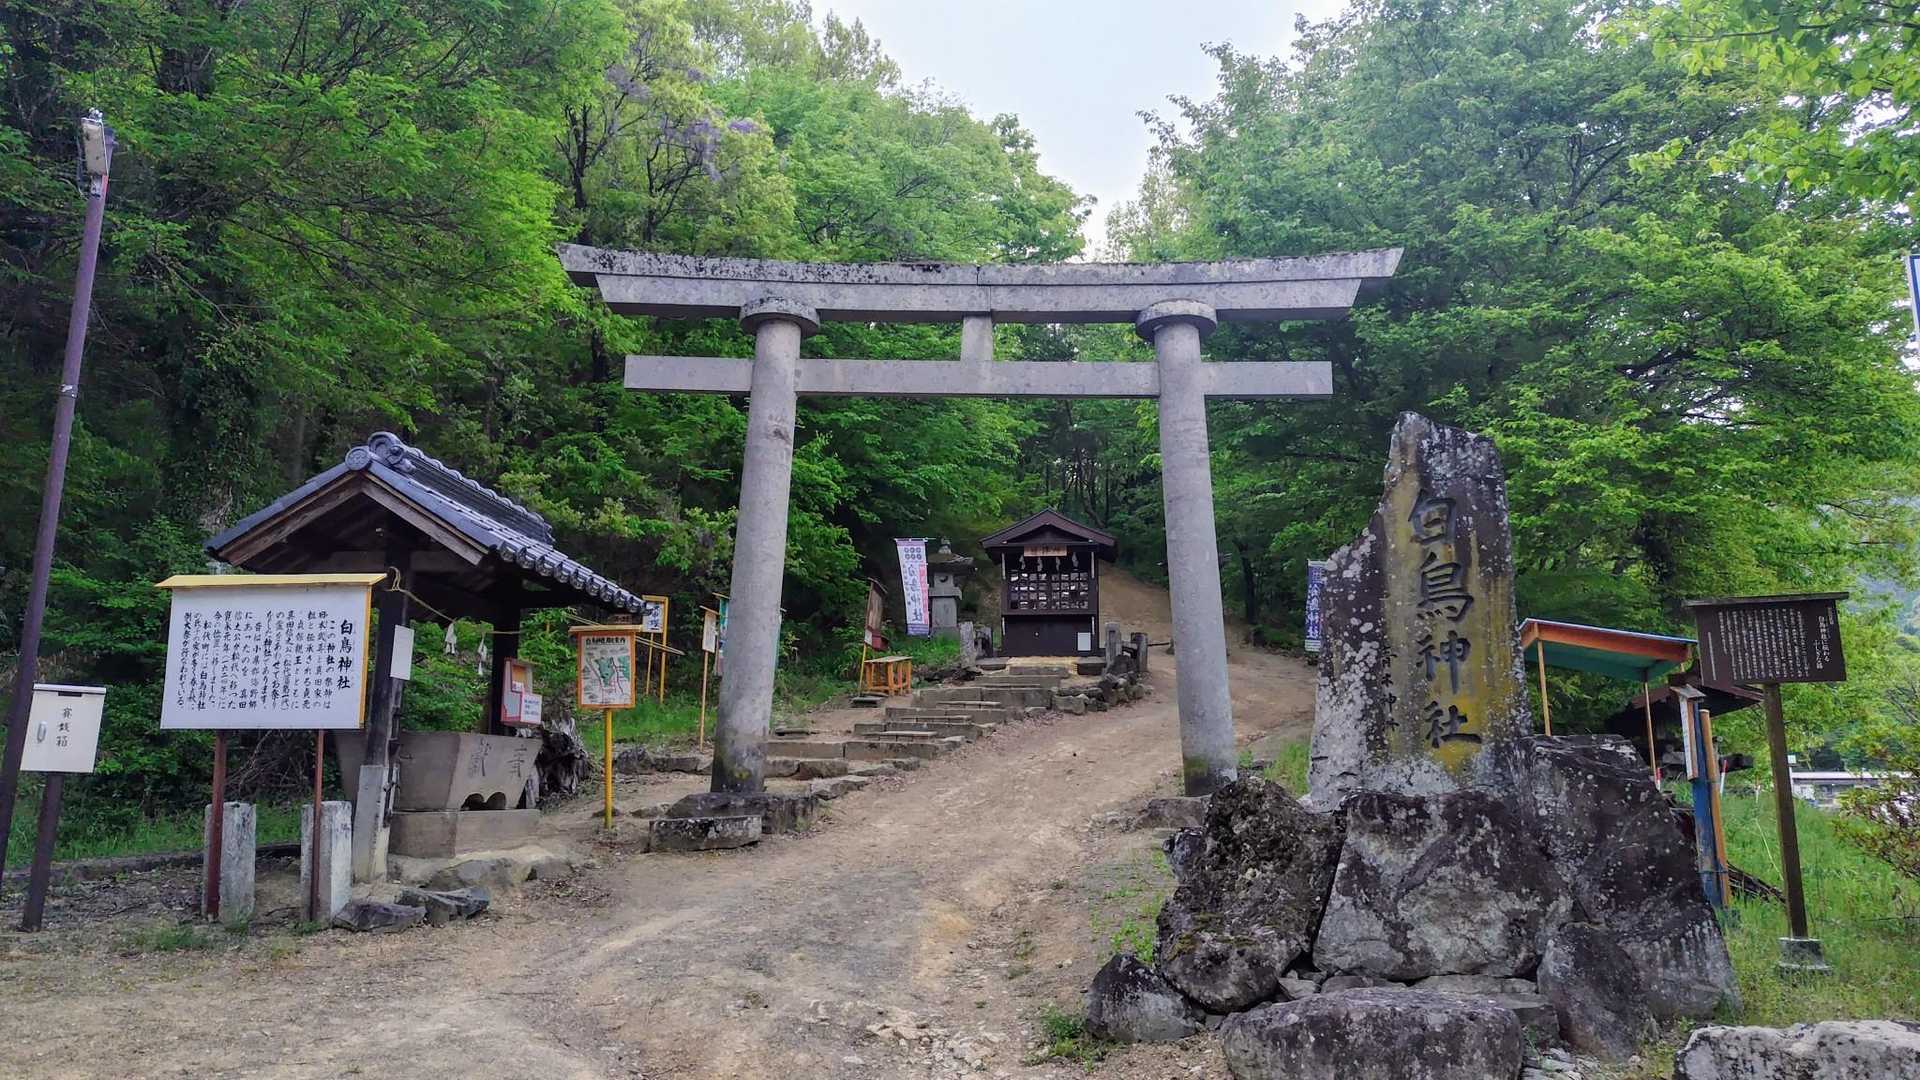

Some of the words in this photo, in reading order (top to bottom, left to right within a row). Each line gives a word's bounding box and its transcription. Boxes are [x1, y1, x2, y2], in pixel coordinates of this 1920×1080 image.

[336, 619, 353, 690] 白鳥神社
[1408, 489, 1482, 748] 白鳥神社
[197, 619, 212, 710] 松代町には白鳥神社
[323, 620, 336, 709] この神社の祭神は
[56, 707, 73, 747] 賽銭箱
